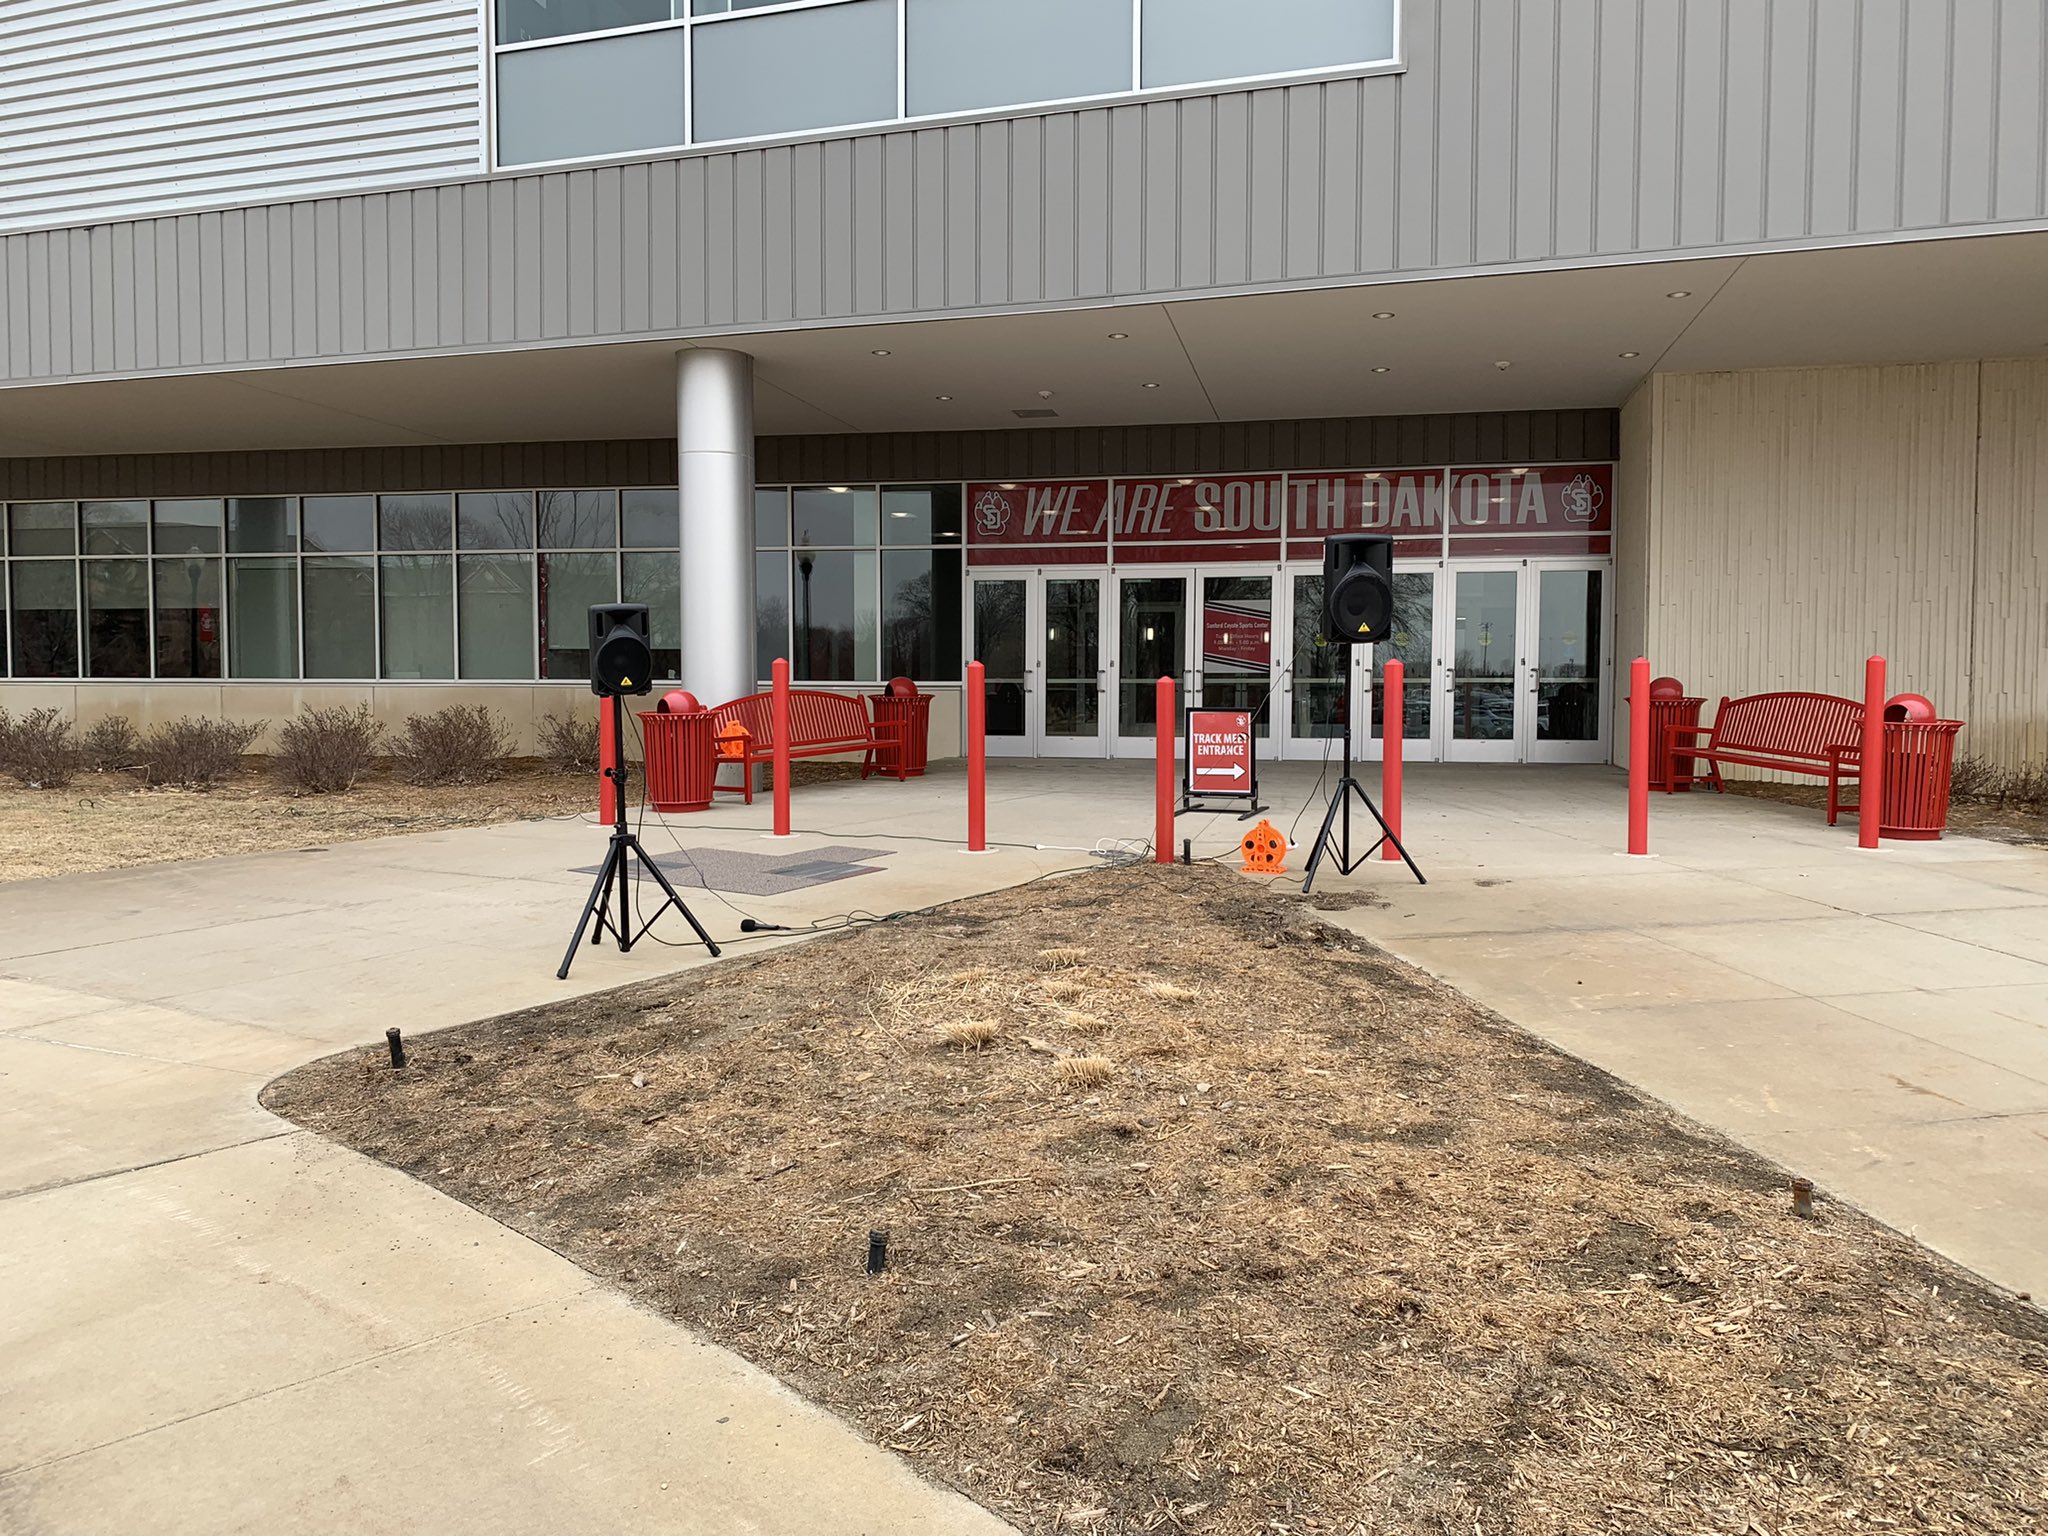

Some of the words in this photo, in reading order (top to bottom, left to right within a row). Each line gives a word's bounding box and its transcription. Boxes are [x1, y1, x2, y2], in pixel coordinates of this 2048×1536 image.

[1023, 485, 1089, 536] WE
[1092, 483, 1182, 535] ARE
[1194, 478, 1346, 533] SOUTH
[1361, 472, 1548, 528] DAKOTA
[1193, 733, 1222, 744] TRACK
[1197, 745, 1245, 756] ENTRANCE
